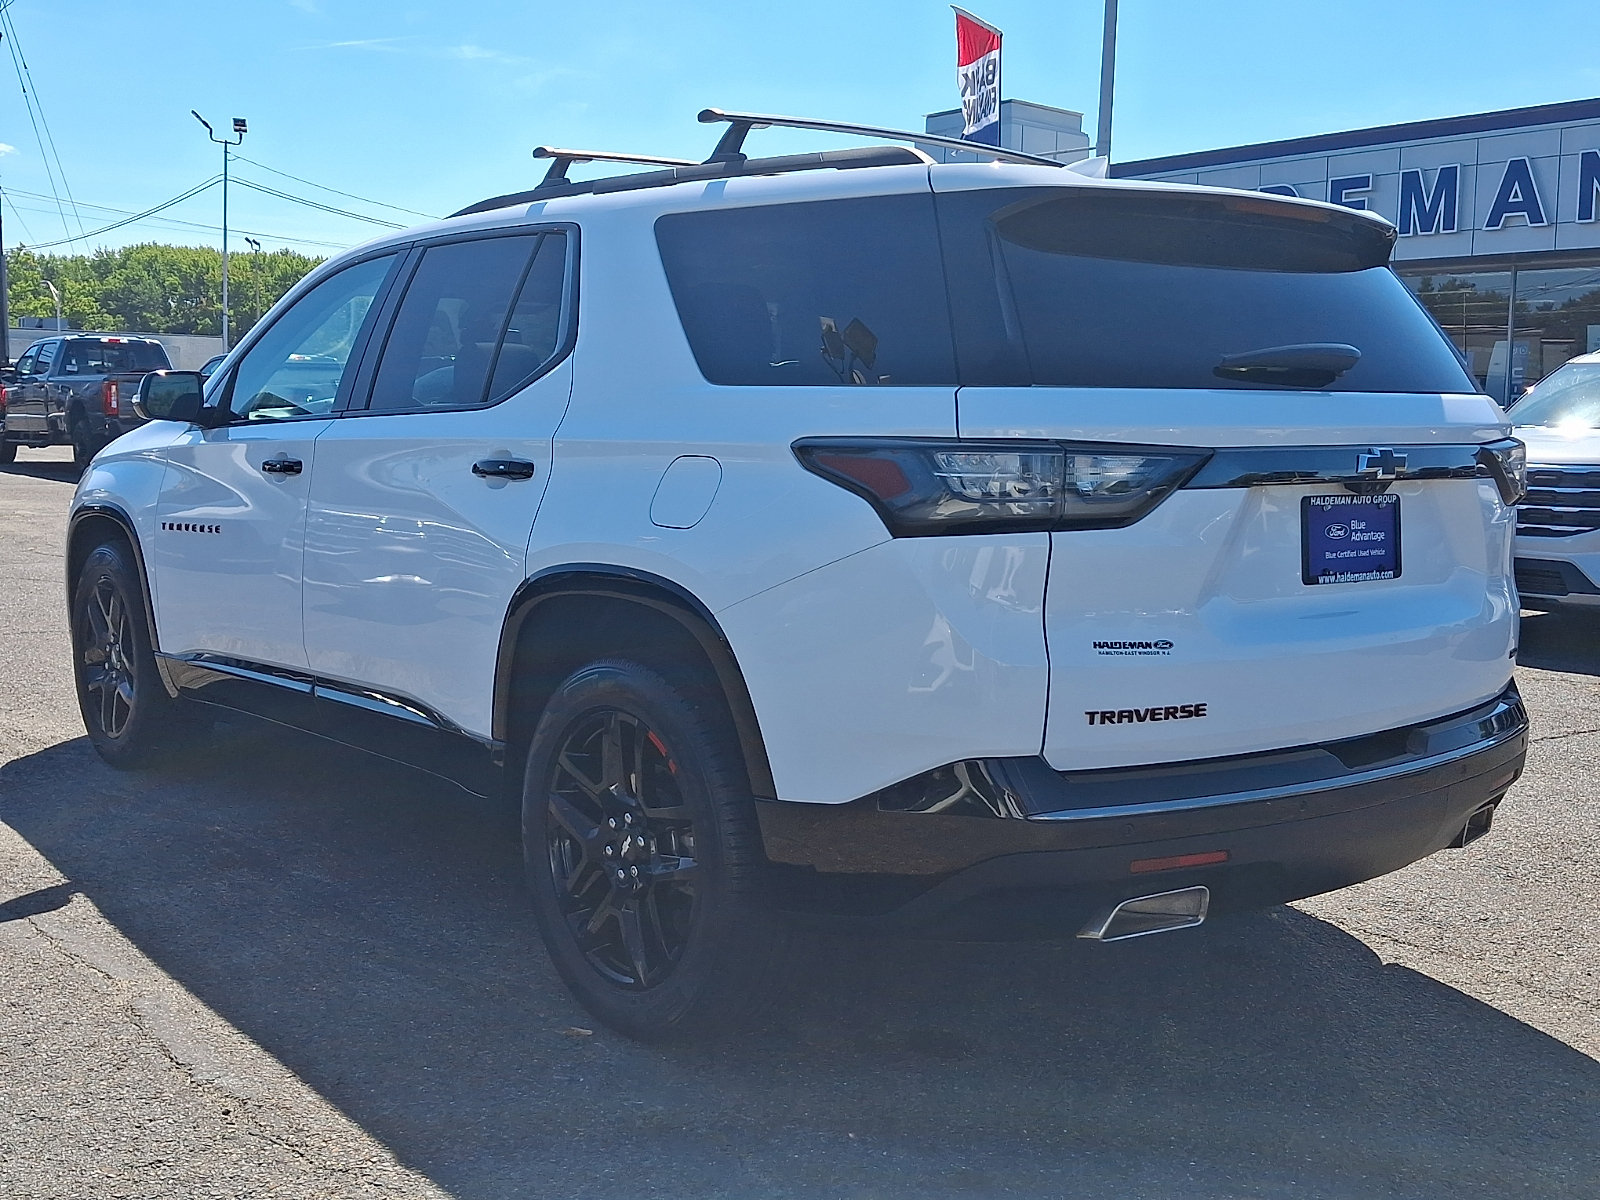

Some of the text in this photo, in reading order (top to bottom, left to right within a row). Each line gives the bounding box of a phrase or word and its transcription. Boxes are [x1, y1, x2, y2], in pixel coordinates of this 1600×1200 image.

[1310, 494, 1397, 506] HALDEMAN AUTO GROUP
[161, 522, 221, 534] TRAVERSE
[1350, 519, 1366, 530] Blue
[1350, 531, 1385, 541] Advantage
[1325, 551, 1337, 559] Blue
[1336, 550, 1357, 558] Certified
[1370, 548, 1386, 556] Vehicle
[1318, 570, 1394, 584] www.haldemanauto.com
[1092, 641, 1153, 650] HALDEMAN
[1084, 703, 1208, 726] TRAVERSE
